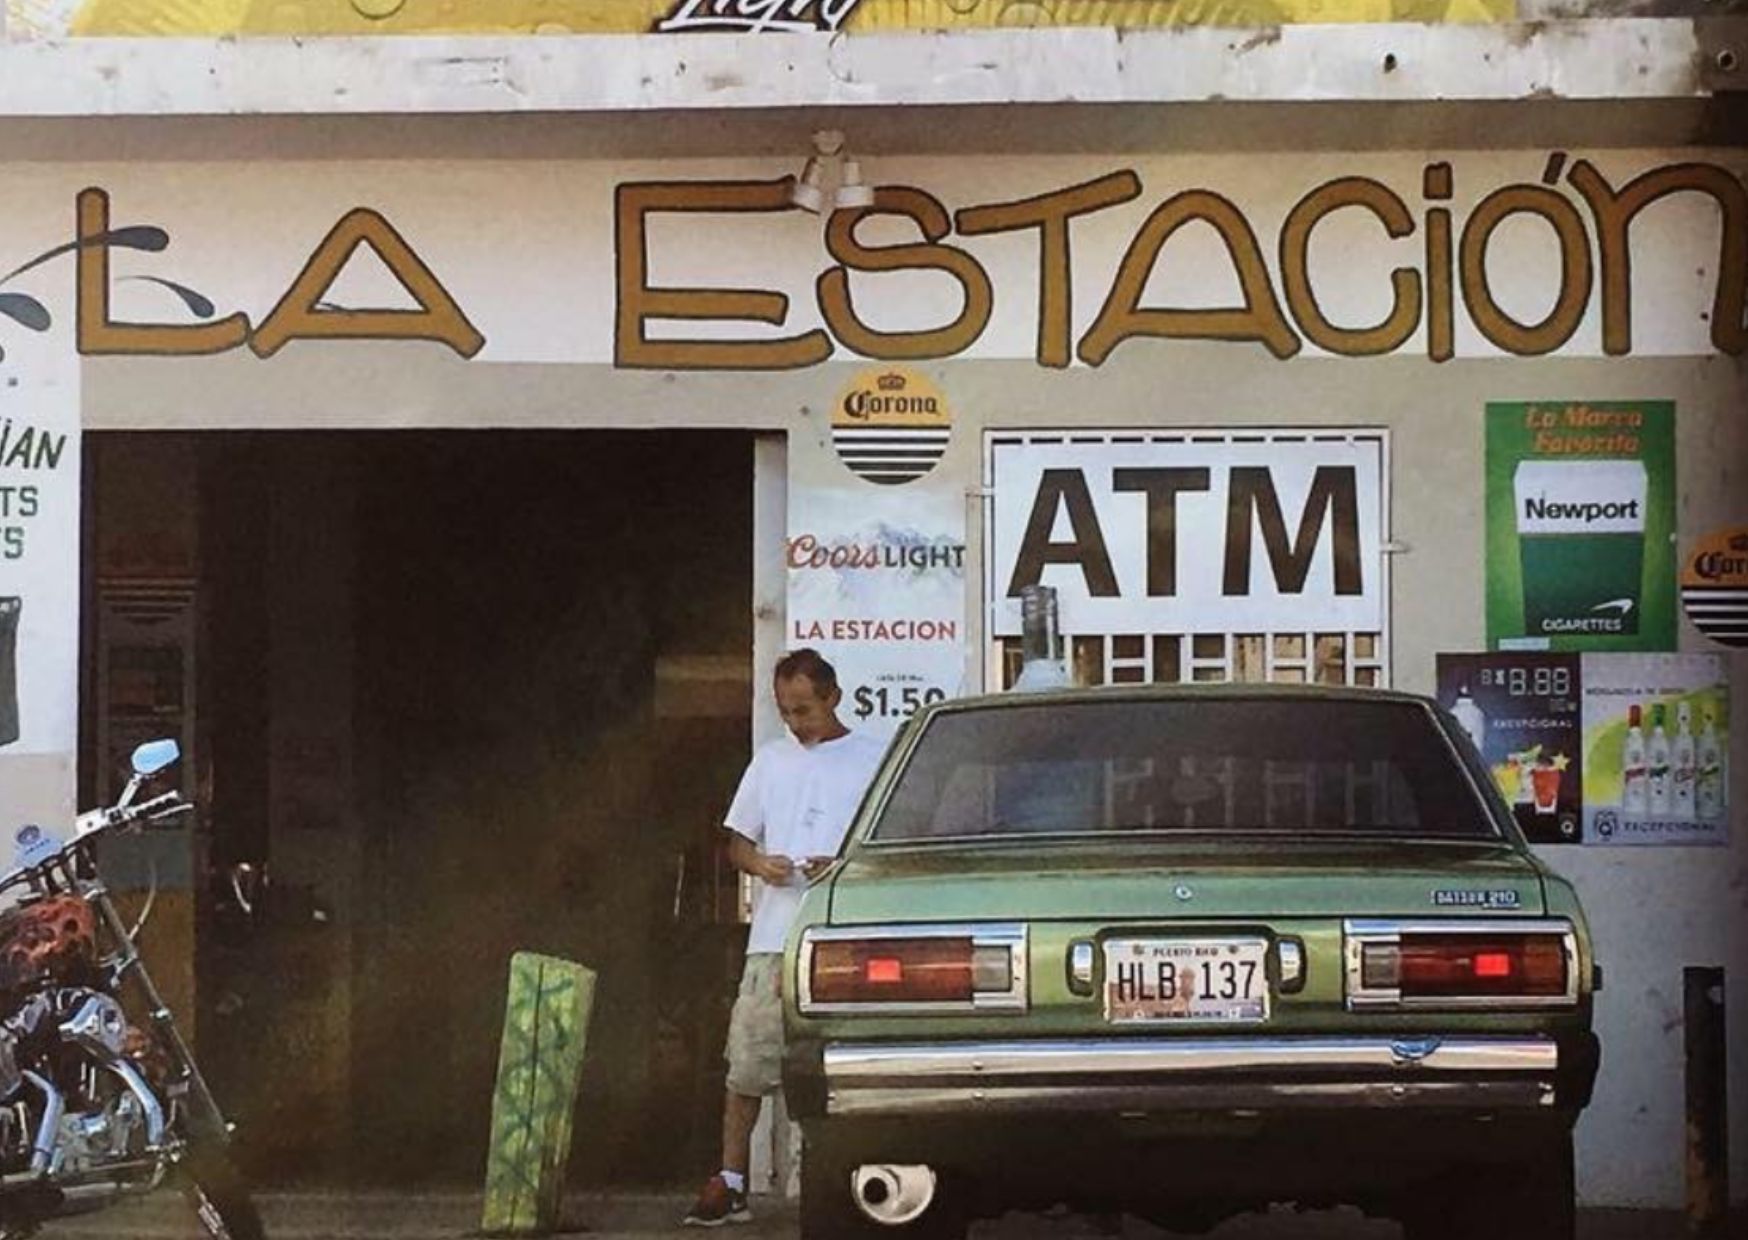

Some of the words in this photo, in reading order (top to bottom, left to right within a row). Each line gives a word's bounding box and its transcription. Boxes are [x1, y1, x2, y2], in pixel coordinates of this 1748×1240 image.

[76, 185, 486, 360] LA
[843, 389, 942, 420] Corona
[1525, 498, 1639, 523] Newport
[1006, 465, 1363, 597] ATM
[787, 534, 881, 569] Coors
[884, 545, 966, 568] LIGHT
[795, 620, 825, 640] LA
[832, 619, 956, 640] ESTACION
[1118, 961, 1177, 1002] HLB
[1199, 960, 1258, 1001] 137
